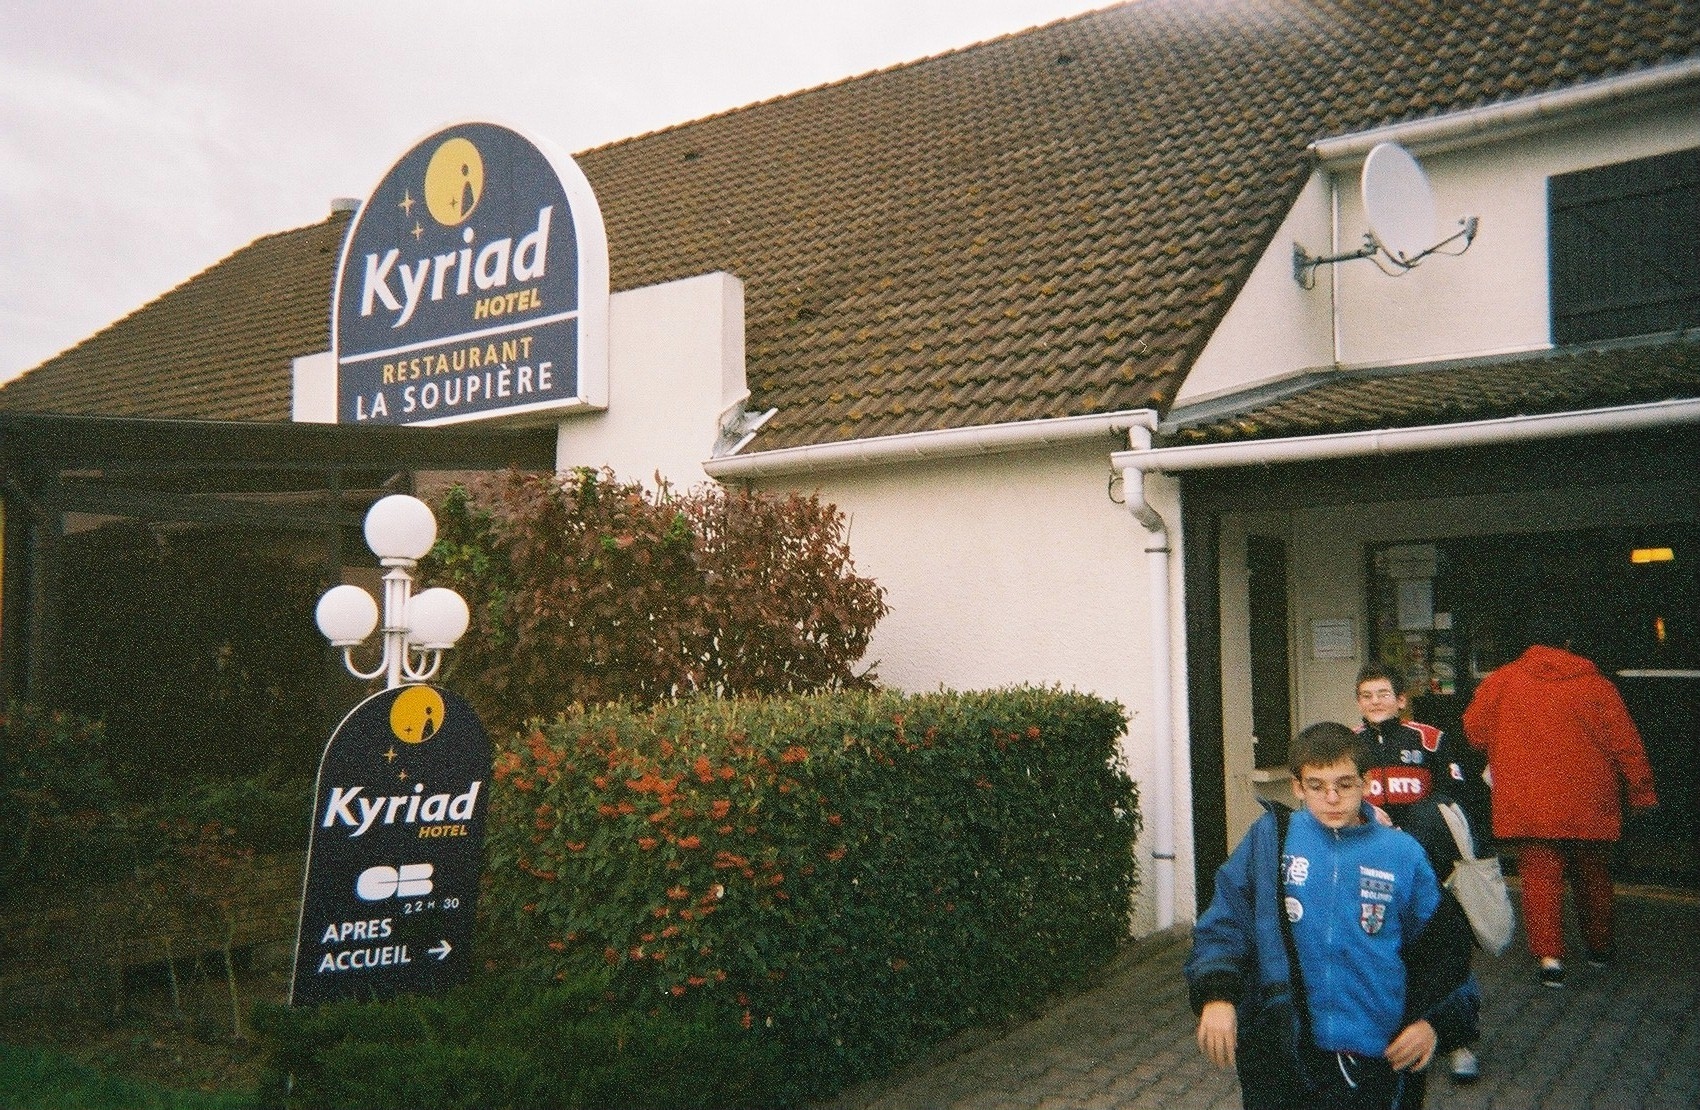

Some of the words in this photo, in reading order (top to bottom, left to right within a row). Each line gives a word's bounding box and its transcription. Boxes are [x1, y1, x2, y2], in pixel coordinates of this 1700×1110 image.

[360, 205, 553, 329] Kyriad
[474, 288, 541, 320] HOTEL
[383, 336, 533, 385] RESTAURANT
[356, 392, 388, 420] LA
[403, 361, 552, 413] SOUPIÈRE
[323, 781, 481, 838] Kyriad
[418, 825, 468, 839] HOTEL
[322, 918, 392, 944] APRES
[319, 945, 411, 973] ACCUEIL
